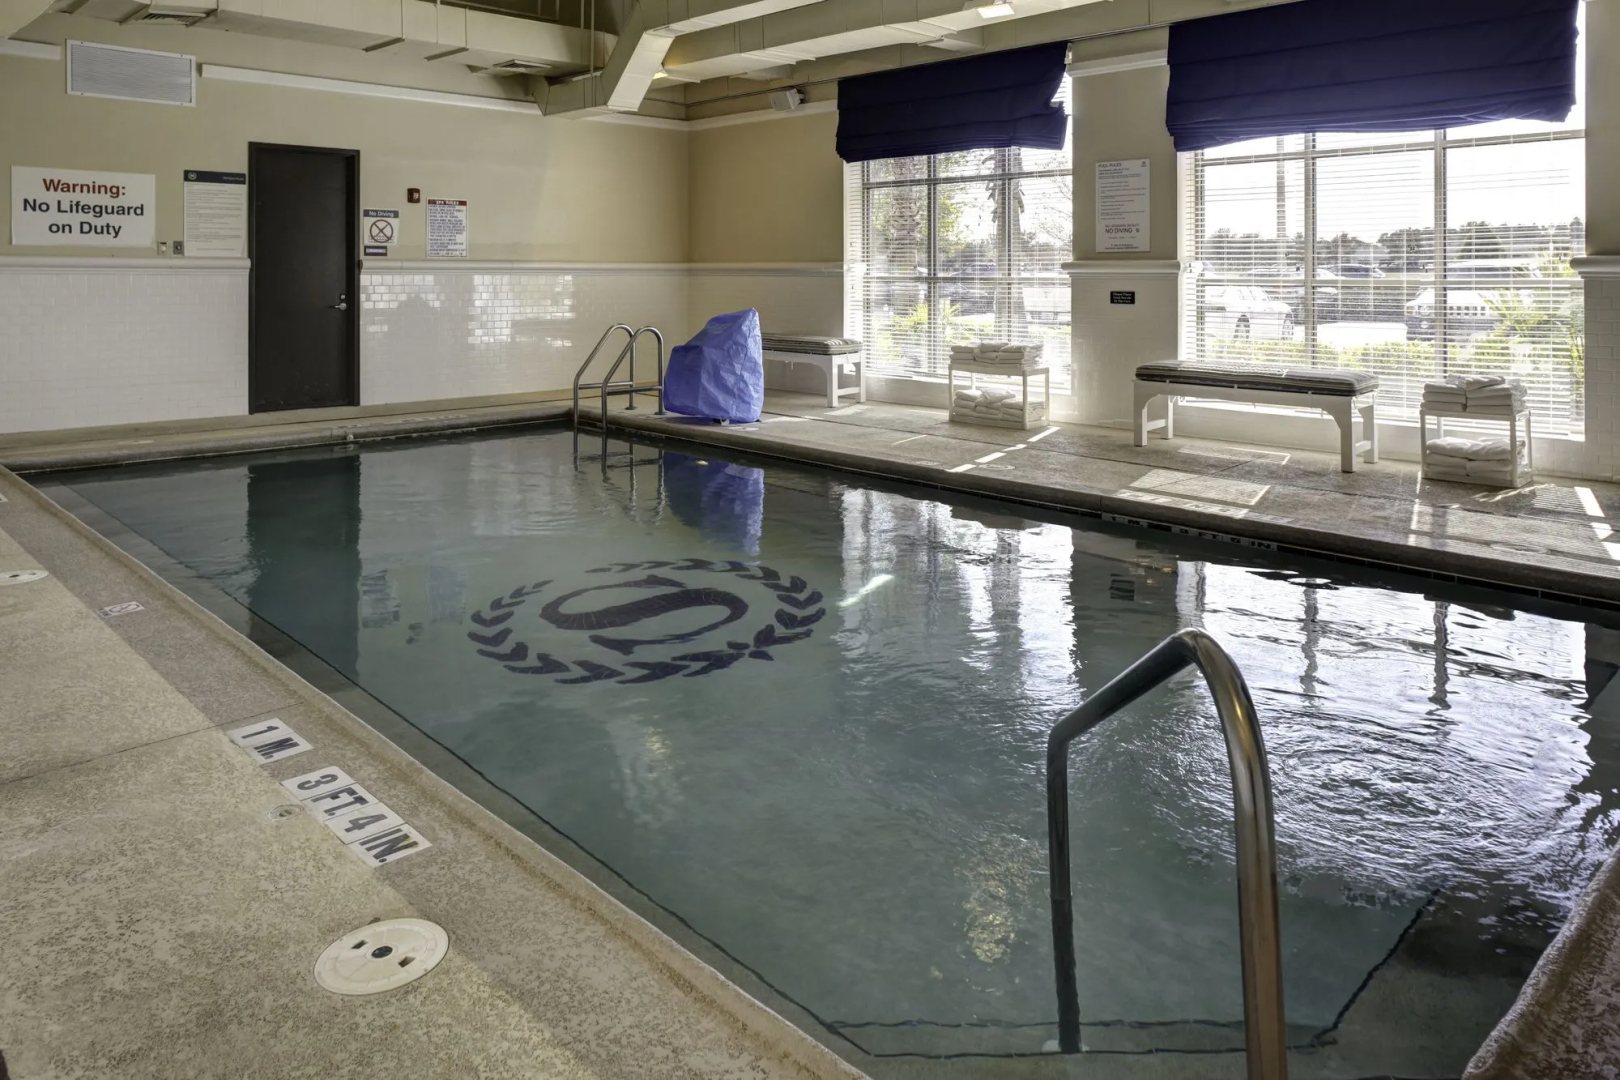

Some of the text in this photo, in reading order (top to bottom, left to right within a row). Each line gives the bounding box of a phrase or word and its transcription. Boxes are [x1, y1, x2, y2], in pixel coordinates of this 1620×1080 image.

[42, 178, 126, 198] Warning:
[23, 198, 144, 218] No Lifeguard
[48, 221, 122, 239] on Duty
[241, 725, 300, 760] 1 M.
[296, 773, 419, 863] 3 FT. 4 IN.
